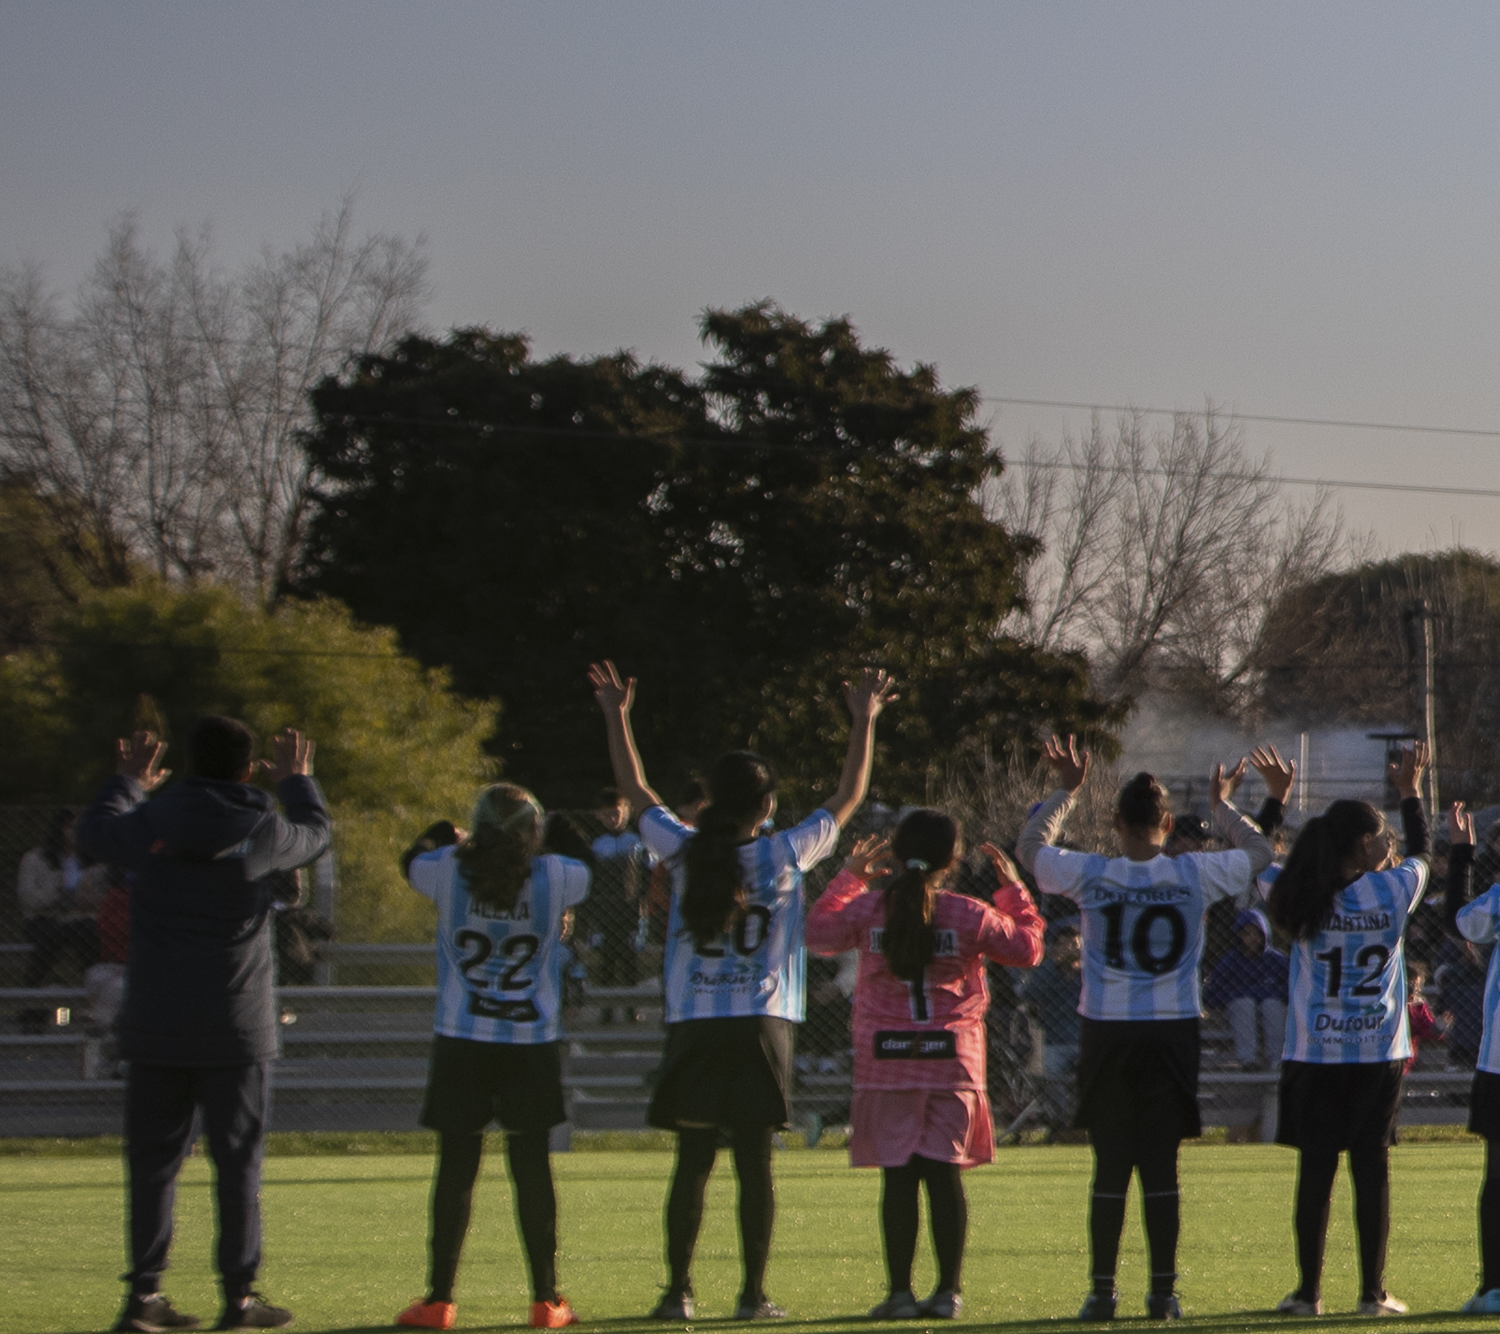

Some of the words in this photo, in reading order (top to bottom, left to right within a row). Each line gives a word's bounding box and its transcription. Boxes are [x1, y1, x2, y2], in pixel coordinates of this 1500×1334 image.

[455, 930, 539, 990] 22
[1100, 902, 1187, 974] 10
[1316, 945, 1389, 998] 12
[1314, 1014, 1385, 1033] Dufour
